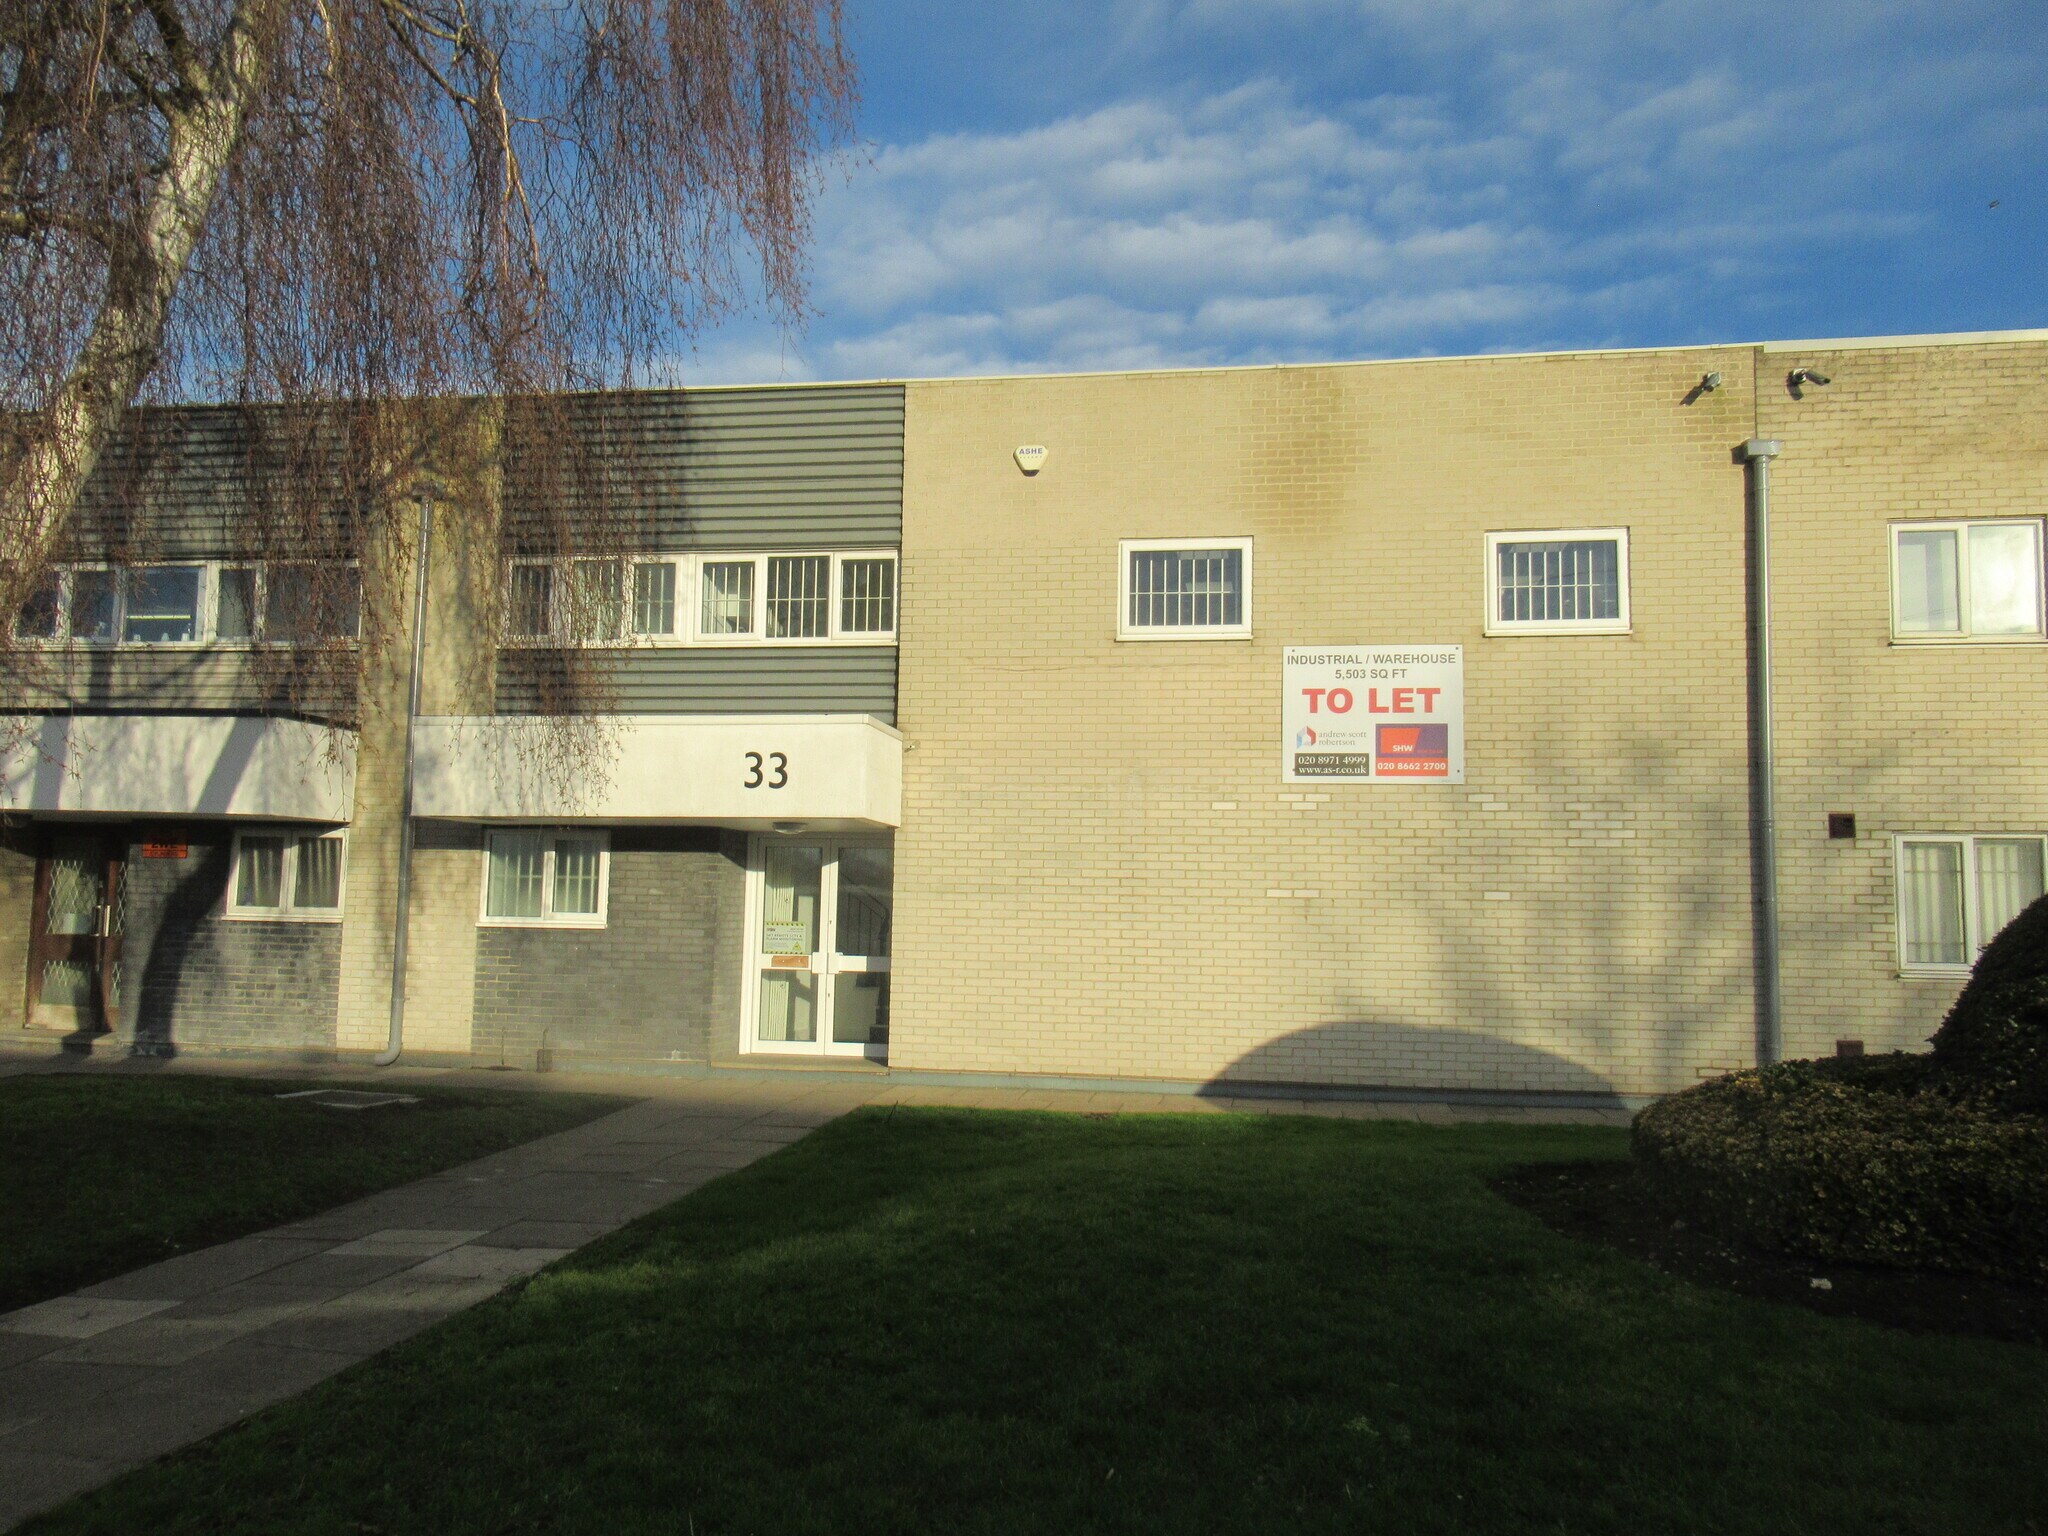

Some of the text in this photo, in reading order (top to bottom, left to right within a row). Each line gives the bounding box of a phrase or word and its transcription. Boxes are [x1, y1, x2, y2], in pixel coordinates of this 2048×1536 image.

[1287, 653, 1456, 665] INDUSTRIAL / WAREHOUSE
[1335, 668, 1408, 680] 5,503 SQ FT
[1301, 687, 1441, 714] TO LET
[1318, 730, 1346, 738] andrew
[1318, 738, 1356, 746] robertson
[1392, 744, 1413, 752] SHW
[1298, 756, 1366, 765] 020 8971 4999
[744, 751, 788, 789] 33
[1298, 765, 1367, 774] www.as-r.co.uk
[1377, 762, 1446, 770] 020 8662 2700
